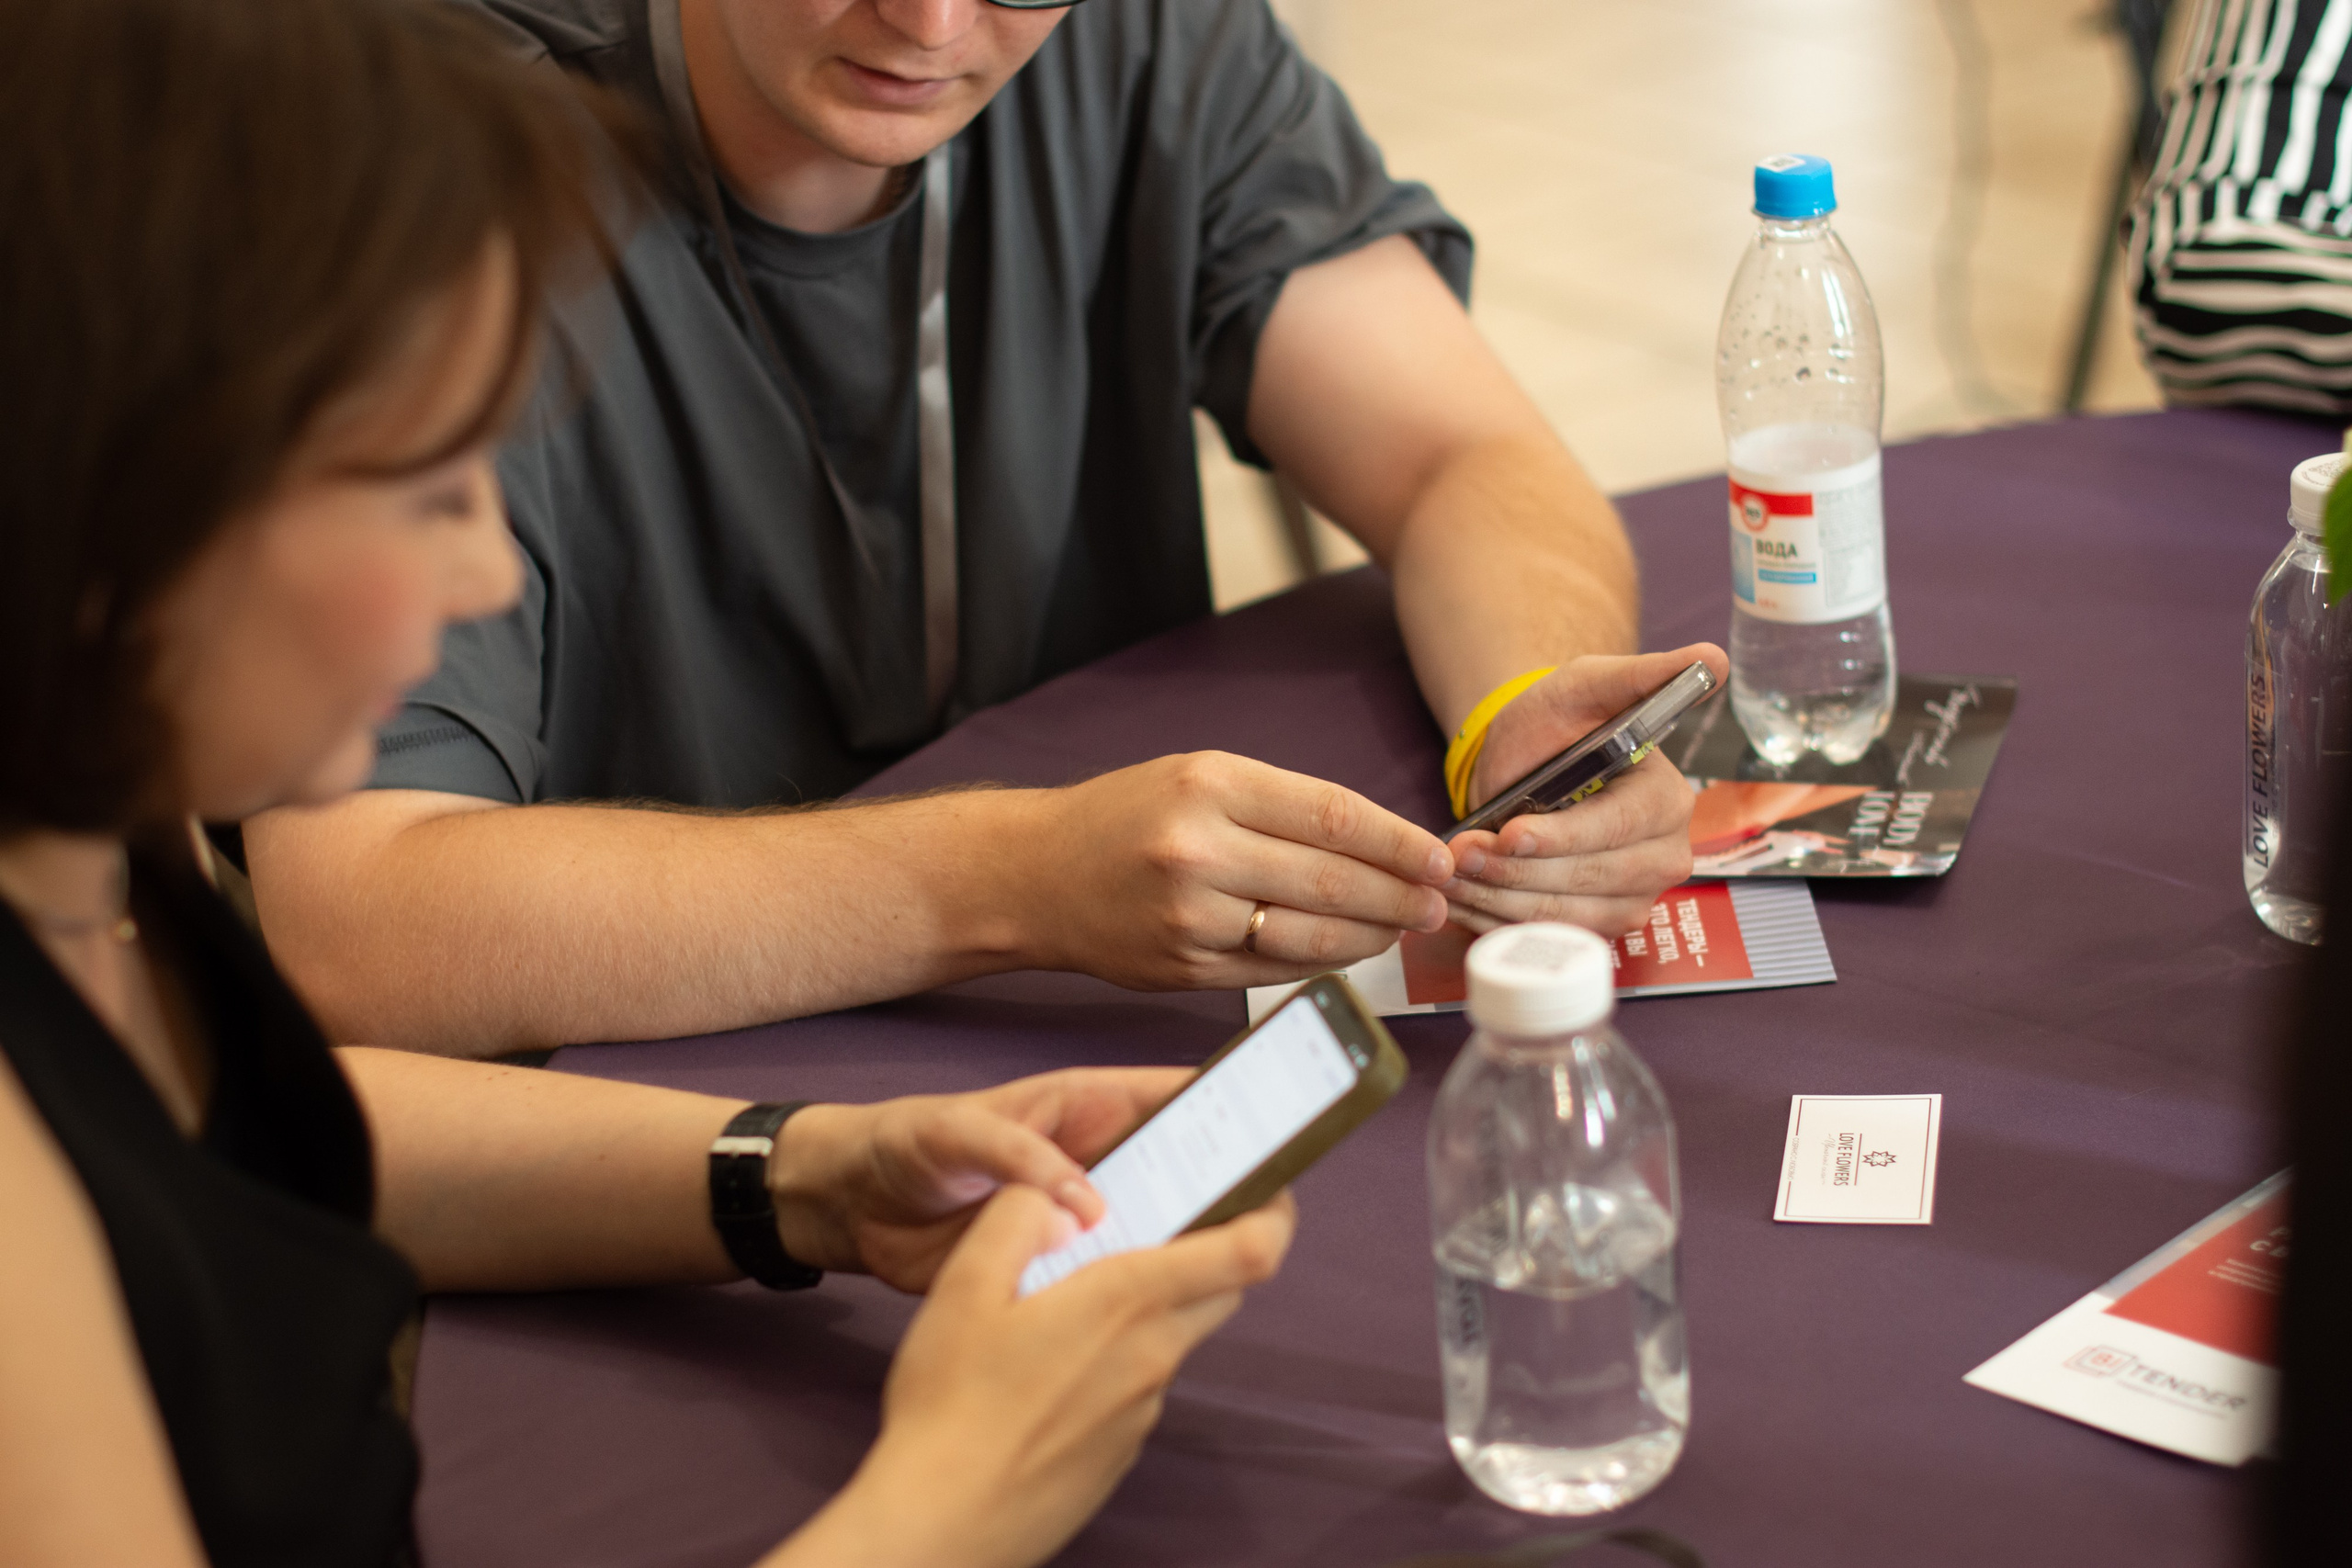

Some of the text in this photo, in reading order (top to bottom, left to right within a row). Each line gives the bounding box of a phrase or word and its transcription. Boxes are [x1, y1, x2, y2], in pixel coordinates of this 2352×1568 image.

[1756, 538, 1798, 558] ВОДА
[2251, 672, 2269, 869] LOVE FLOWERS
[1883, 791, 1933, 846] BODY
[1650, 902, 1670, 926] ЭТО
[1676, 897, 1709, 954] ТЕНДЕРЫ
[1833, 1133, 1854, 1186] LOVE FLOWERS
[2128, 1363, 2247, 1409] TENDER
